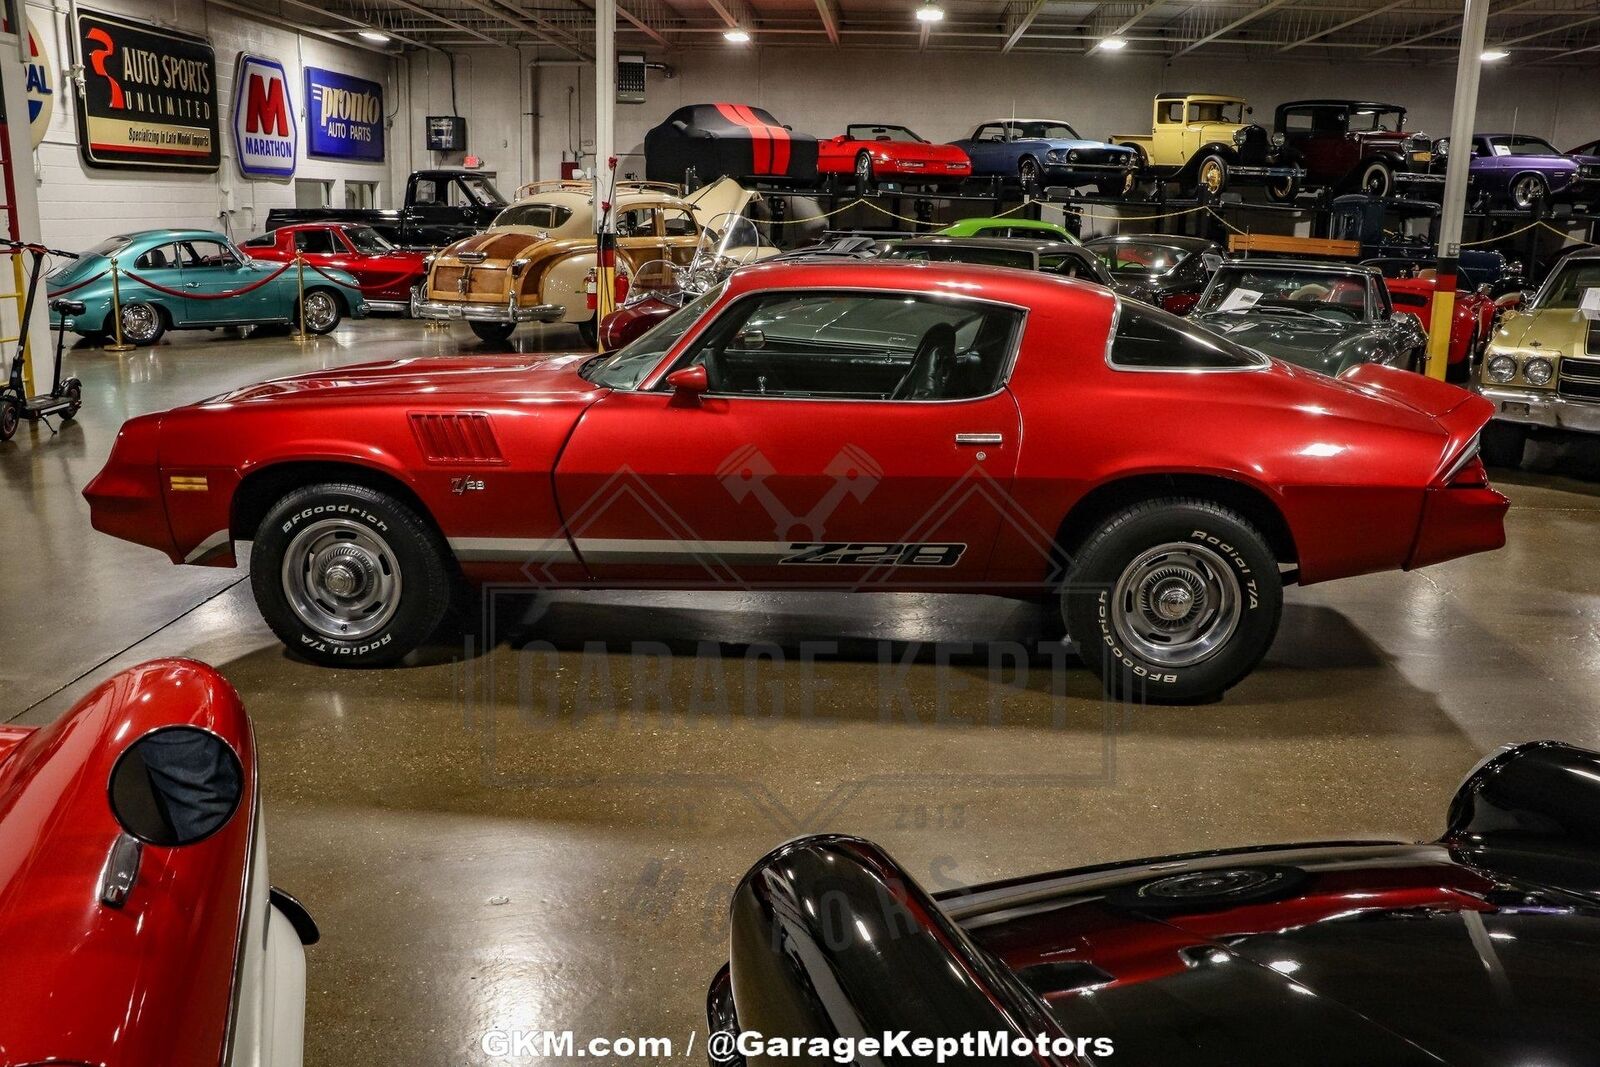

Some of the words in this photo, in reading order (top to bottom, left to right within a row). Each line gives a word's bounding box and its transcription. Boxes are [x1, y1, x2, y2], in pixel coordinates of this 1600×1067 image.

[24, 64, 53, 94] AL
[122, 47, 159, 86] AUTO
[162, 55, 210, 95] SPORTS
[125, 91, 211, 120] UNLIMITED
[246, 73, 289, 137] M
[320, 86, 380, 126] pronto
[128, 127, 160, 145] Specializing
[177, 132, 191, 145] Model
[192, 133, 209, 148] Imports
[328, 122, 346, 139] AUTO
[350, 126, 371, 142] PARTS
[245, 137, 292, 158] MARATHON
[451, 475, 485, 496] Z/28
[281, 504, 389, 534] BFGoodrich
[778, 543, 967, 567] Z28
[1190, 529, 1252, 575] Radial
[1246, 579, 1259, 611] T/A
[300, 634, 326, 653] T/A
[332, 633, 393, 656] Radial
[1096, 590, 1179, 684] BFGoodrich
